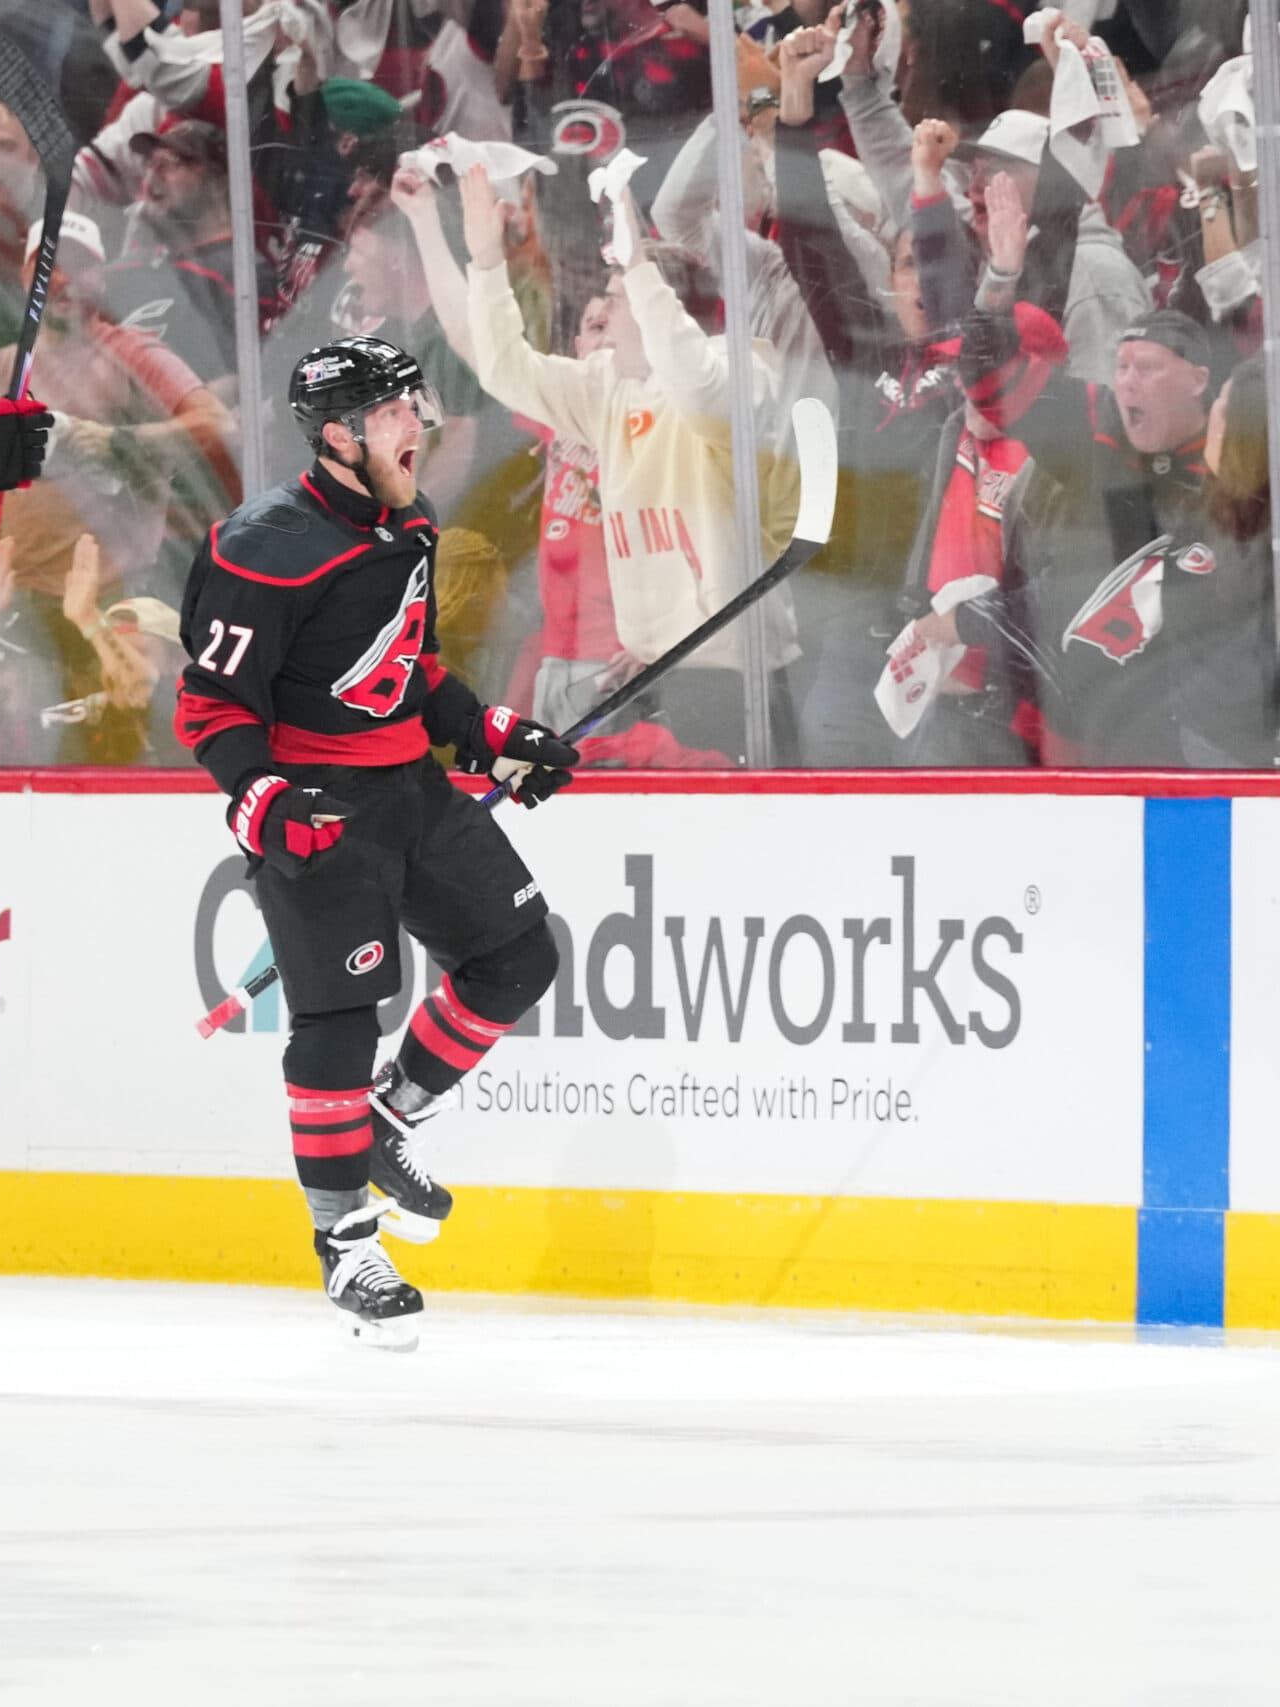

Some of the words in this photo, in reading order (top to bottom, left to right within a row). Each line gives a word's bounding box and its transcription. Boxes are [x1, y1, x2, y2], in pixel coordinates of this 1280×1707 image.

[197, 619, 255, 677] 27
[476, 1070, 615, 1115] Solutions
[627, 1072, 740, 1118] Crafted
[752, 1076, 818, 1120] with
[830, 1077, 919, 1123] Pride.
